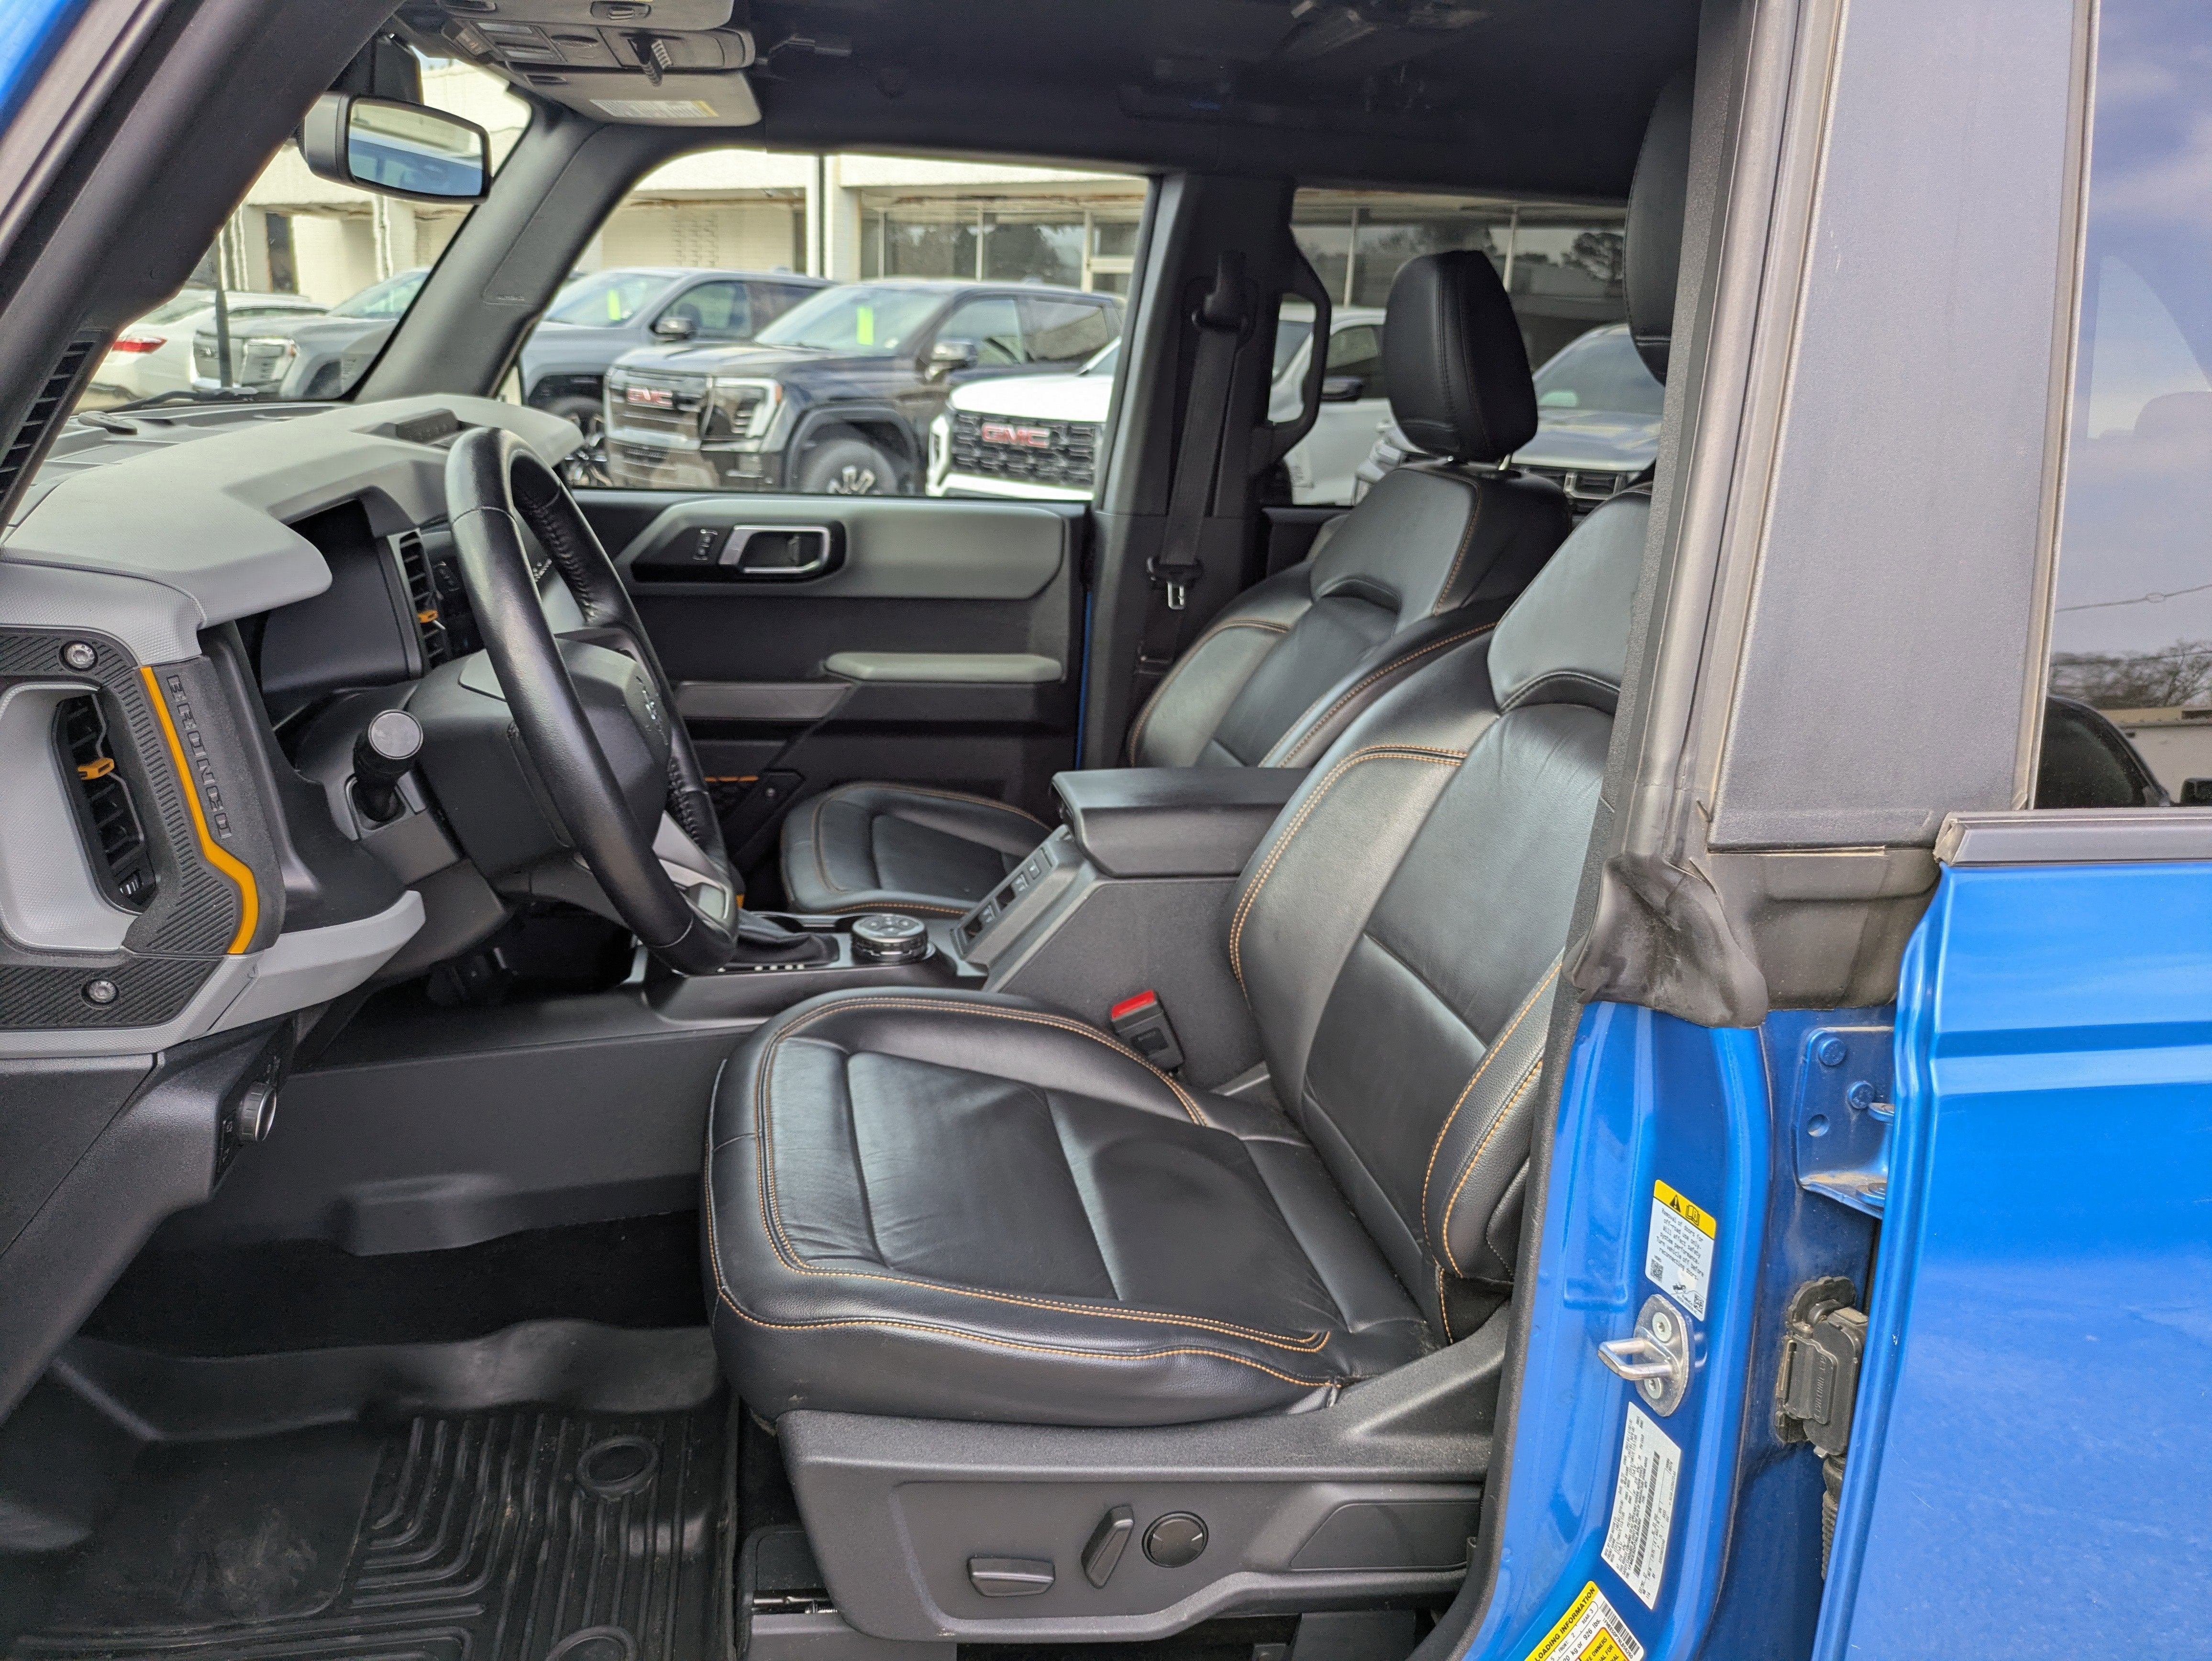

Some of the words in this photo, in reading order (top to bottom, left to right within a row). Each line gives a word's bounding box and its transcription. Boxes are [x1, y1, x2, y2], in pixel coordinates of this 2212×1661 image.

[981, 422, 1051, 448] GMC
[166, 675, 232, 839] BRONCO
[1535, 1632, 1560, 1661] LOADING
[1559, 1587, 1596, 1634] INFORMATION
[1571, 1647, 1578, 1656] kg
[1583, 1628, 1593, 1640] 926
[1592, 1617, 1601, 1628] lbs.
[1592, 1637, 1607, 1656] OWNERS
[1605, 1644, 1613, 1654] FOR
